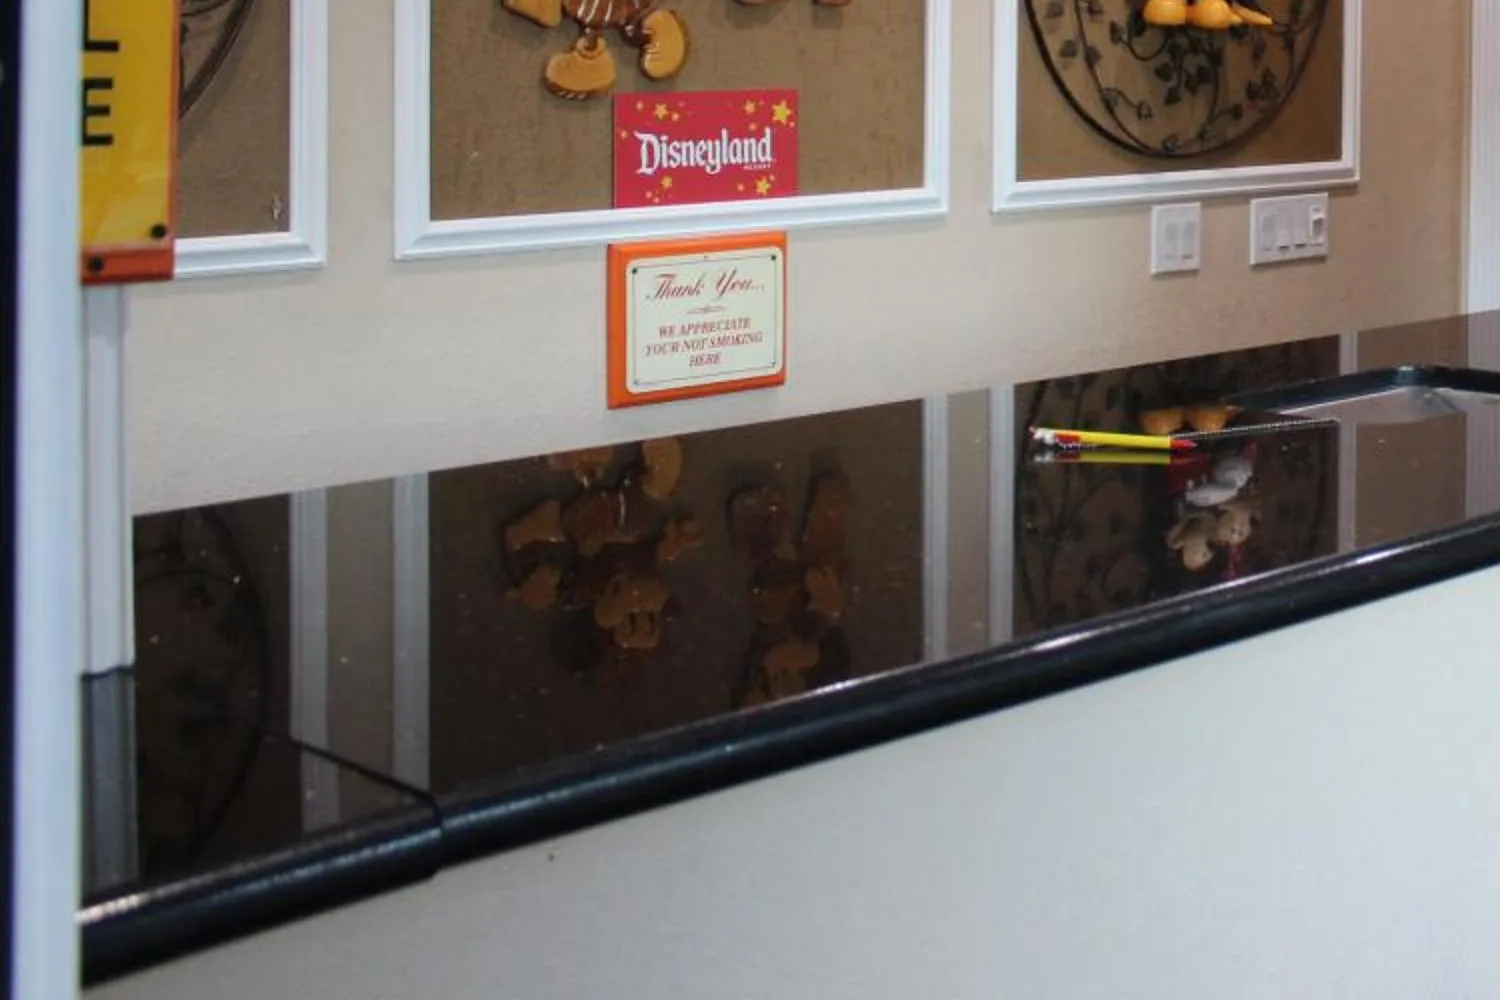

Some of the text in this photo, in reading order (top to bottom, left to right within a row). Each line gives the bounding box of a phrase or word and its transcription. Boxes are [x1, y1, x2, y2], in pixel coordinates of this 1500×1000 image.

[633, 126, 773, 175] Disneyland
[650, 271, 706, 300] Thank
[658, 317, 751, 338] WE APPRECIATE
[681, 338, 708, 352] NOT
[709, 331, 763, 349] SMOKING
[688, 353, 721, 368] HERE
